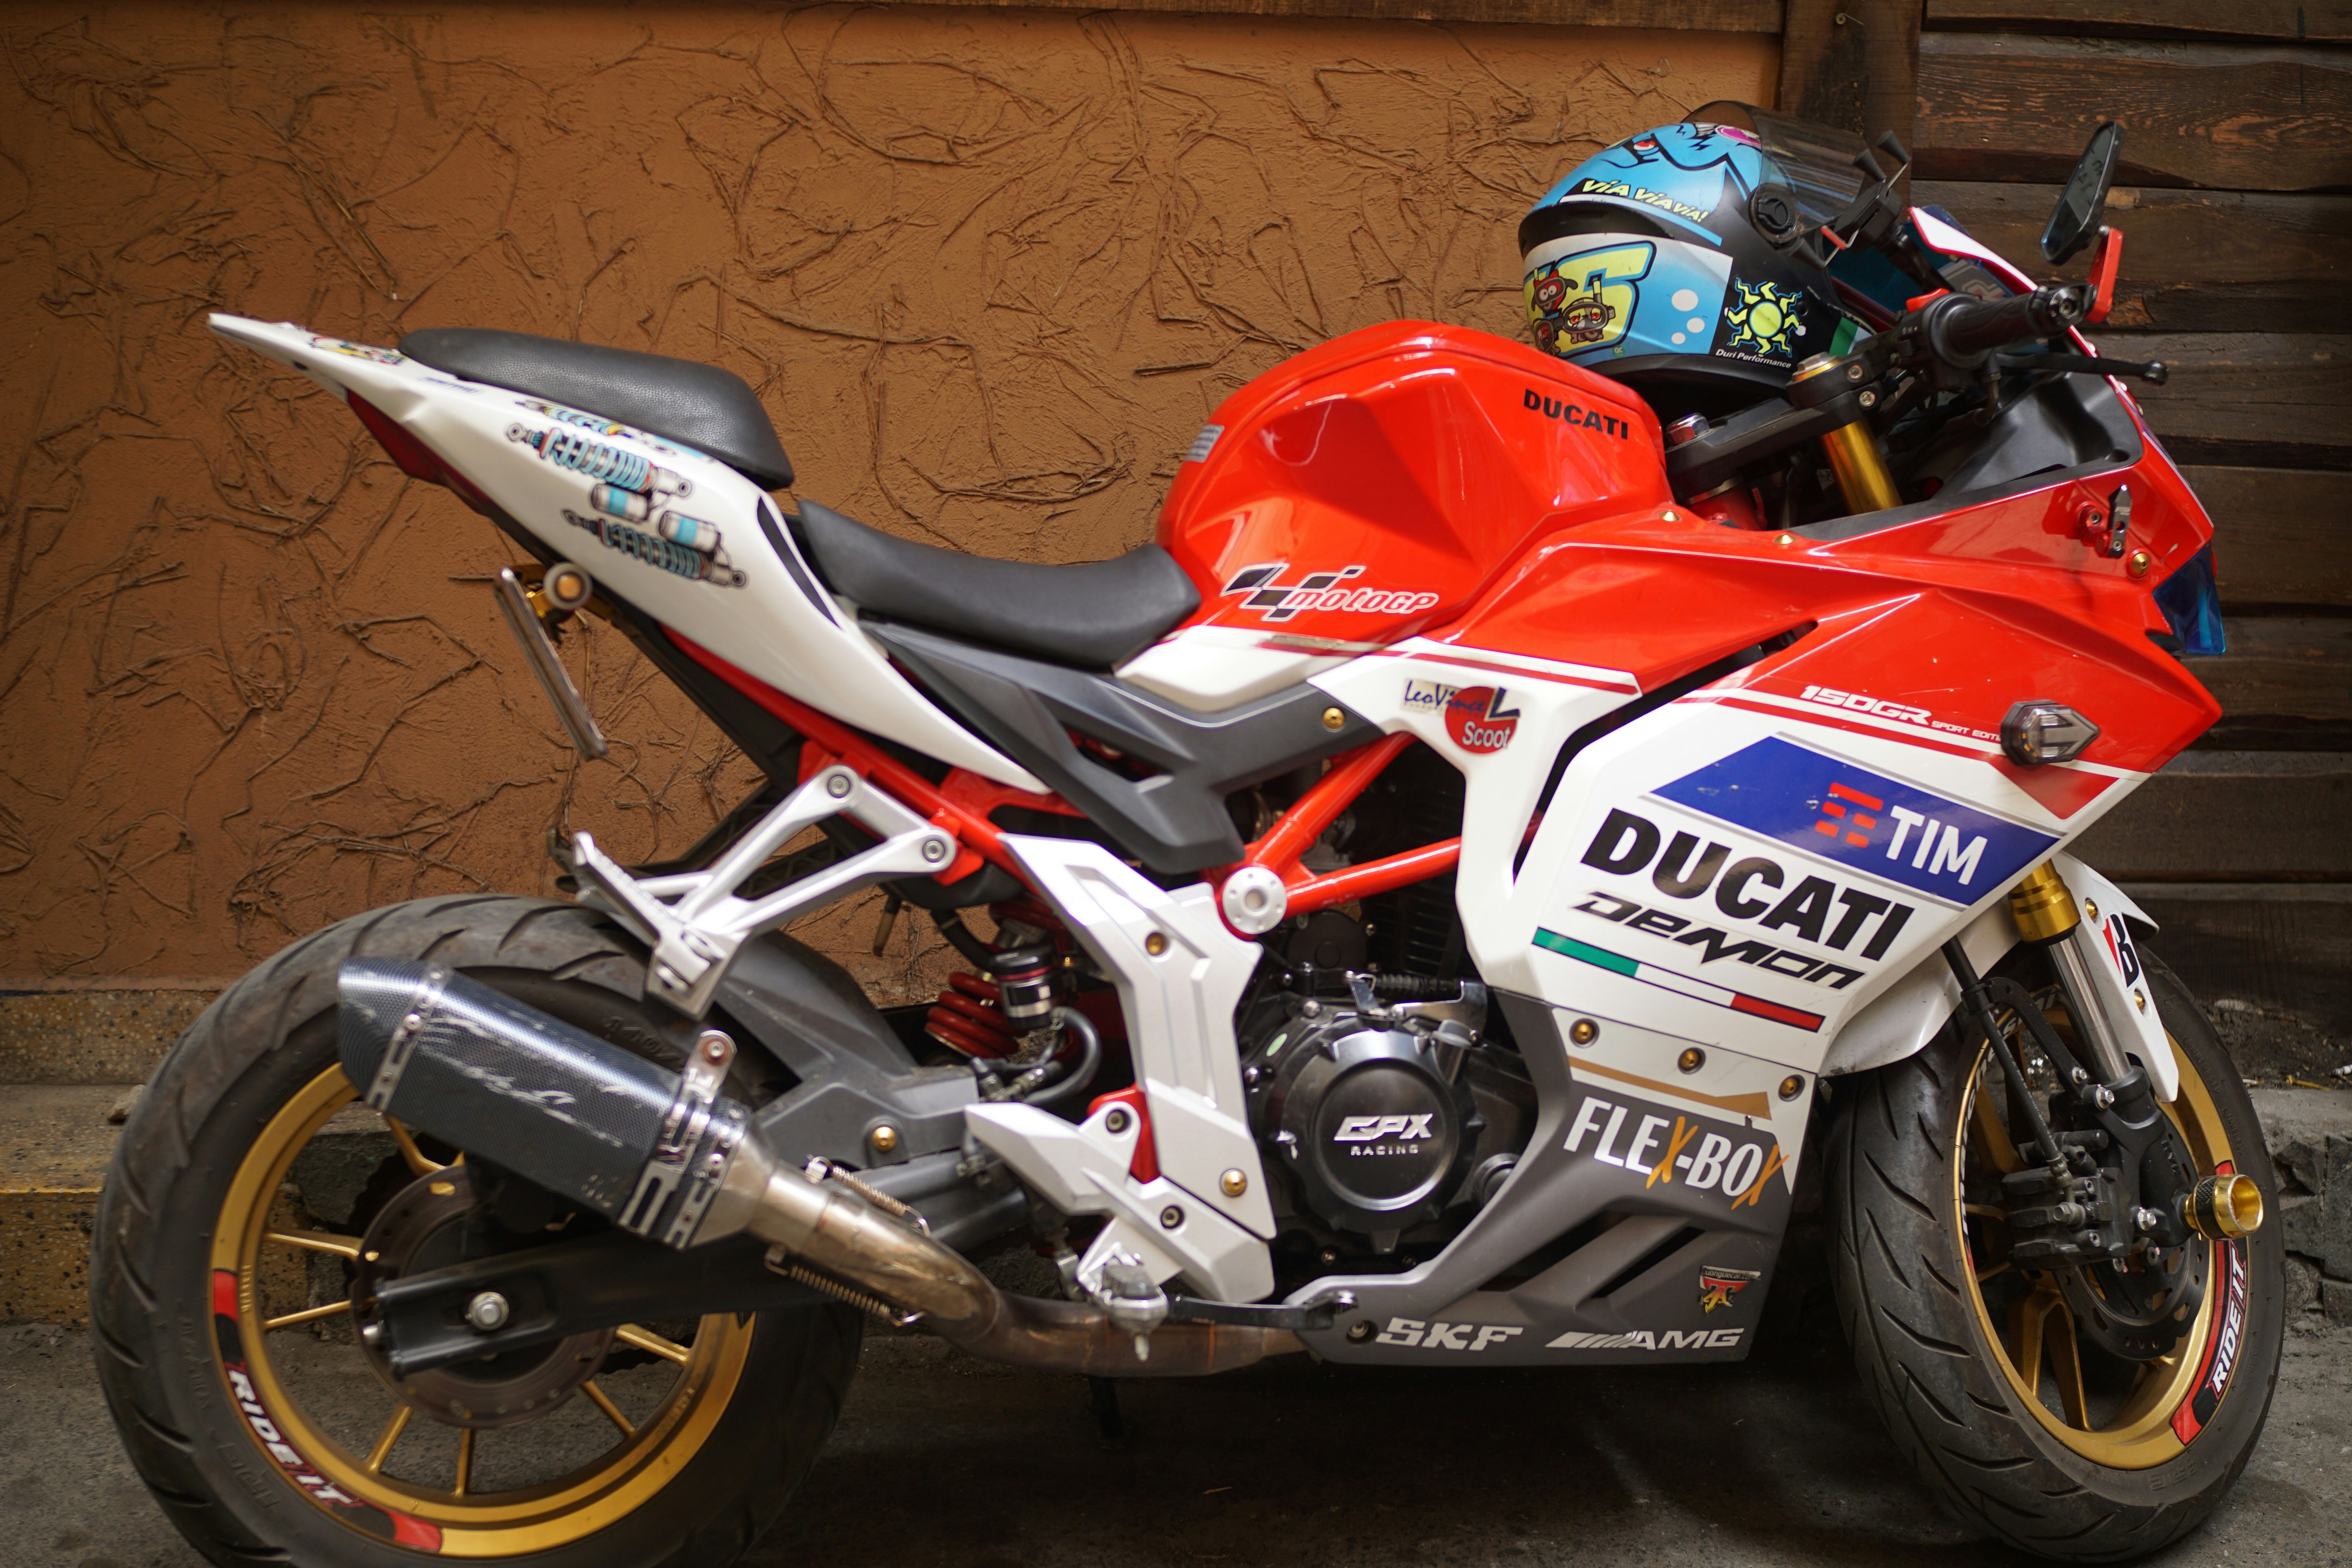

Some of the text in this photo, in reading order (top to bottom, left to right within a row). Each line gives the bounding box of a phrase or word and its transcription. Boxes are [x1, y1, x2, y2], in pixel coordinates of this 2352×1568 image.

[1523, 388, 1628, 440] DUCATI
[1462, 720, 1511, 749] Scoot
[1800, 685, 1932, 725] 150GR
[1931, 720, 1971, 735] SPORT
[1887, 806, 1987, 885] TIM
[1581, 808, 1915, 961] DUCATI
[1334, 1113, 1433, 1141] GPX
[1351, 1145, 1419, 1156] RACING
[1563, 1096, 1790, 1210] FLEX-BOX
[1376, 1317, 1523, 1350] SKF
[1619, 1329, 1744, 1350] AMG
[2212, 1247, 2244, 1392] RIDE IT
[229, 1370, 303, 1466] RIDE
[297, 1475, 352, 1504] IT
